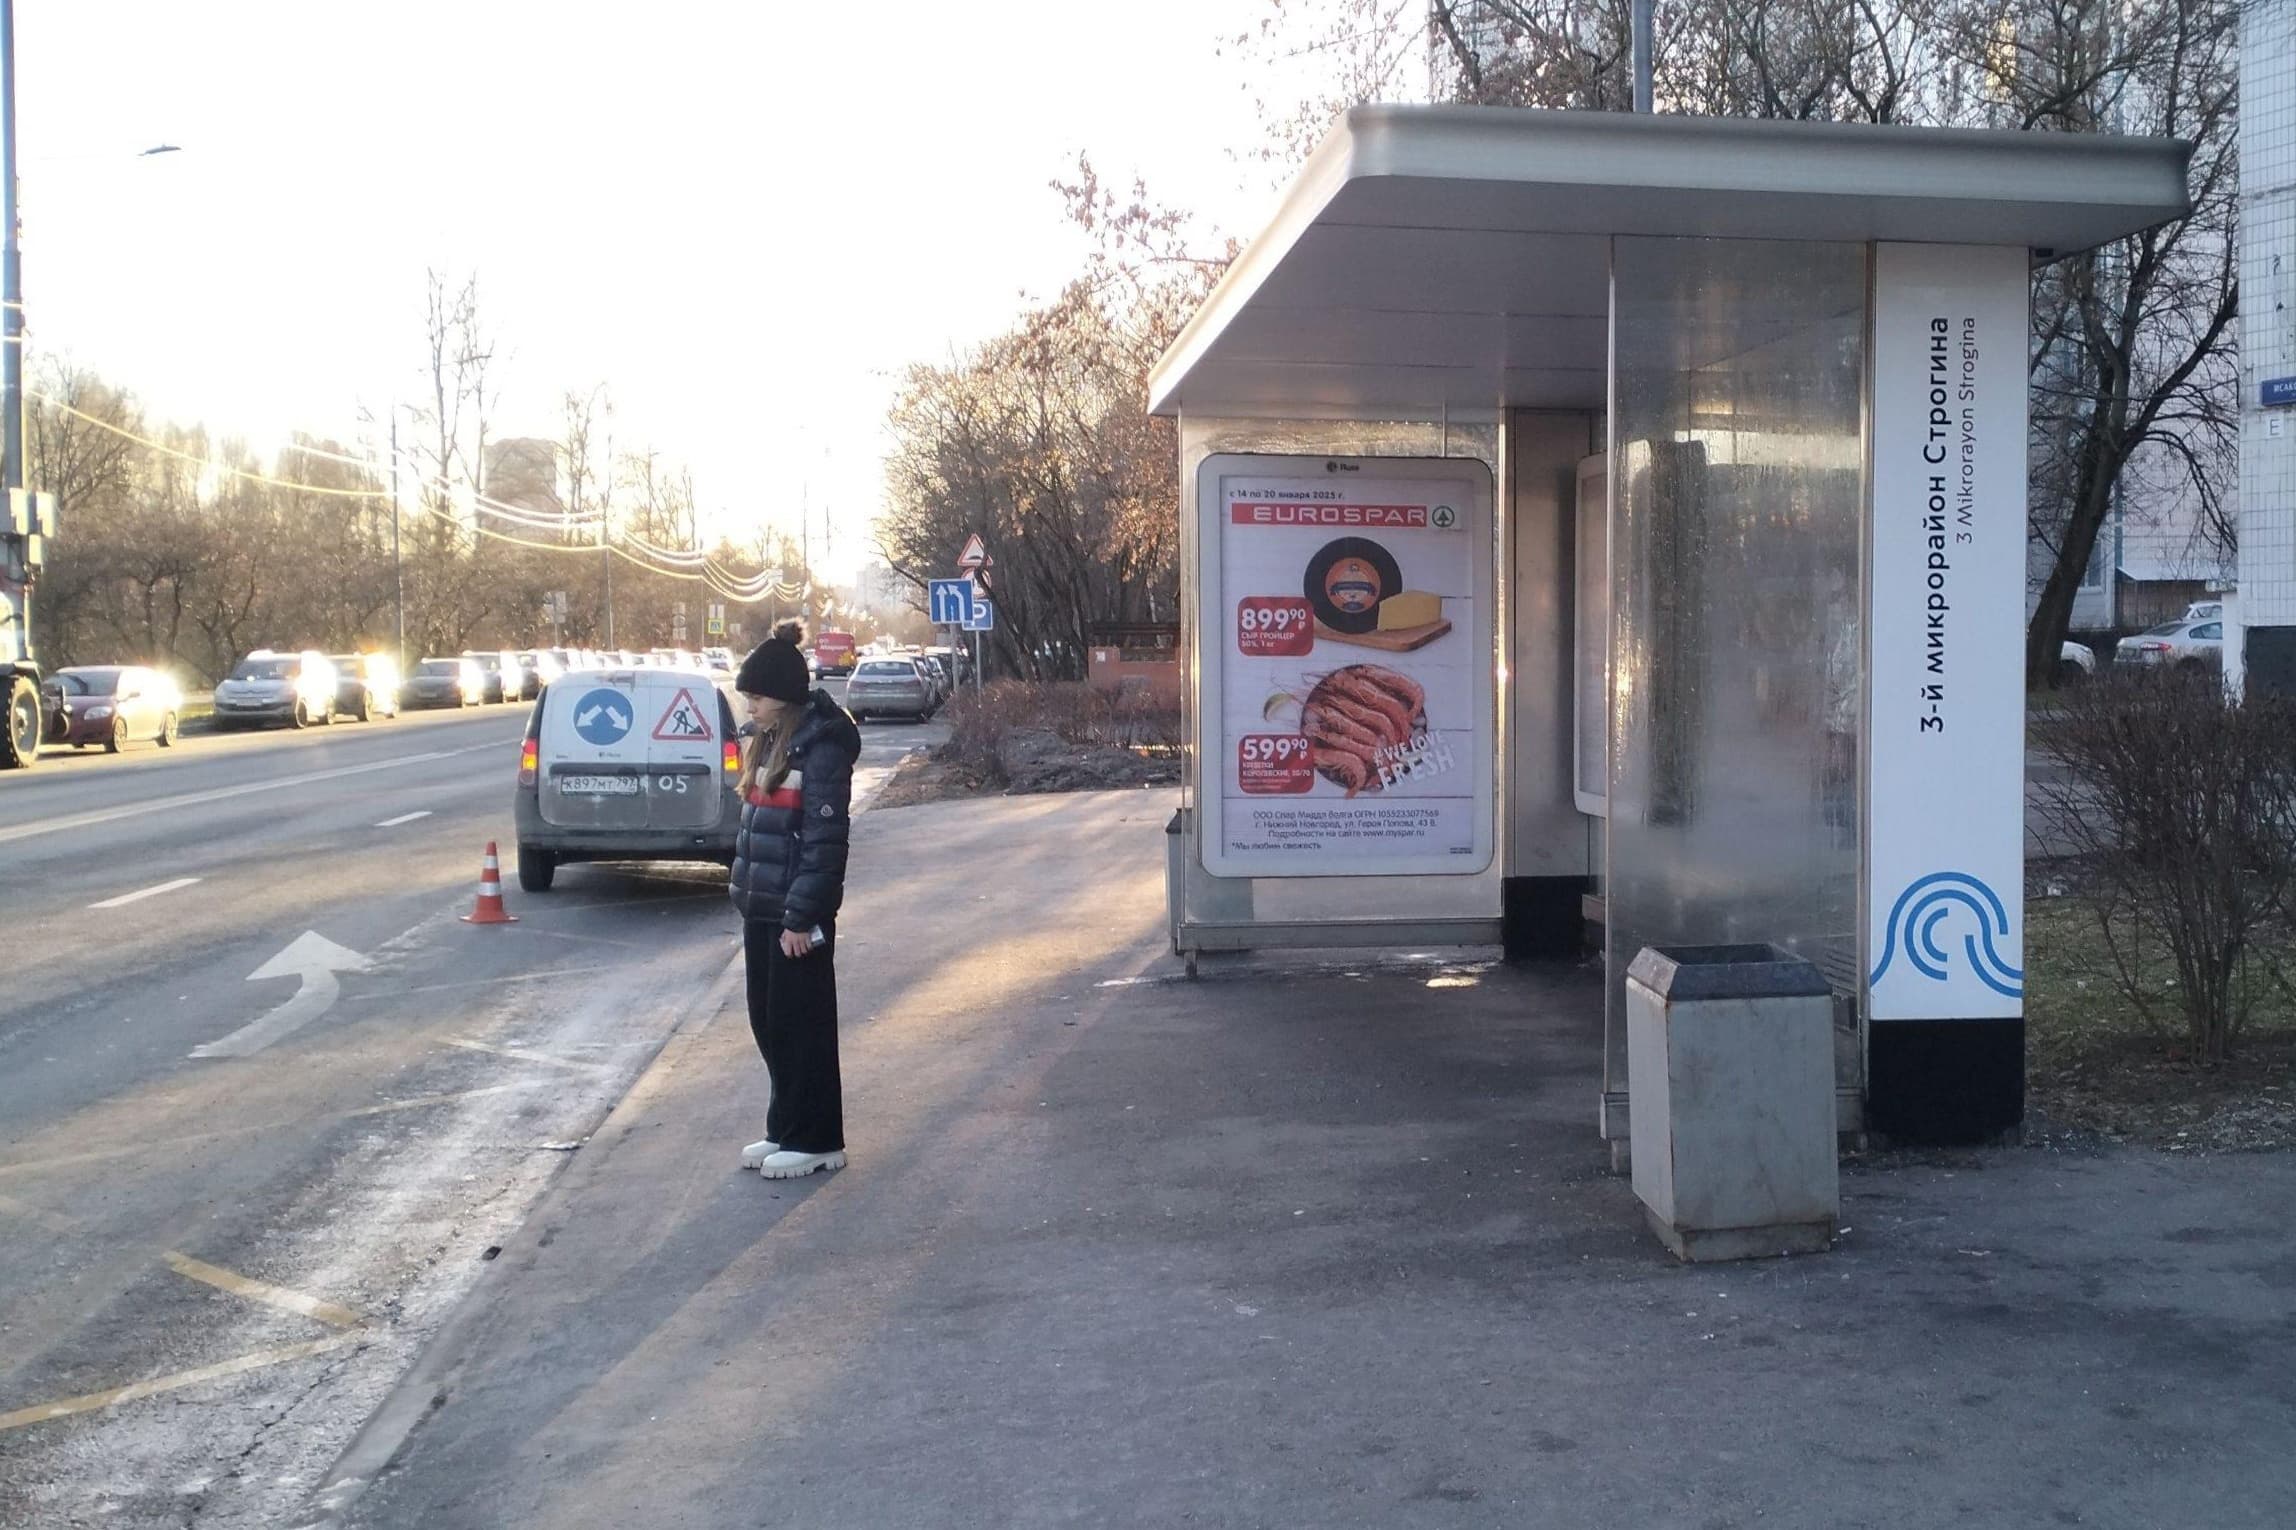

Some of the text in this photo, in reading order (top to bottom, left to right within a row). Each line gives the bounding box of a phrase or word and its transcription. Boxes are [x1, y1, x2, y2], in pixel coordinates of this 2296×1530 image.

[1956, 316, 1980, 544] 3 Mikrorayon Strogina
[1264, 490, 1276, 498] 20
[1312, 491, 1336, 499] 2025
[1252, 506, 1425, 524] EUROSPAR
[1921, 316, 1952, 733] 3-й микрорайон Строгина
[1241, 607, 1289, 630] 899
[1242, 738, 1291, 760] 599
[1253, 810, 1273, 819] ООО
